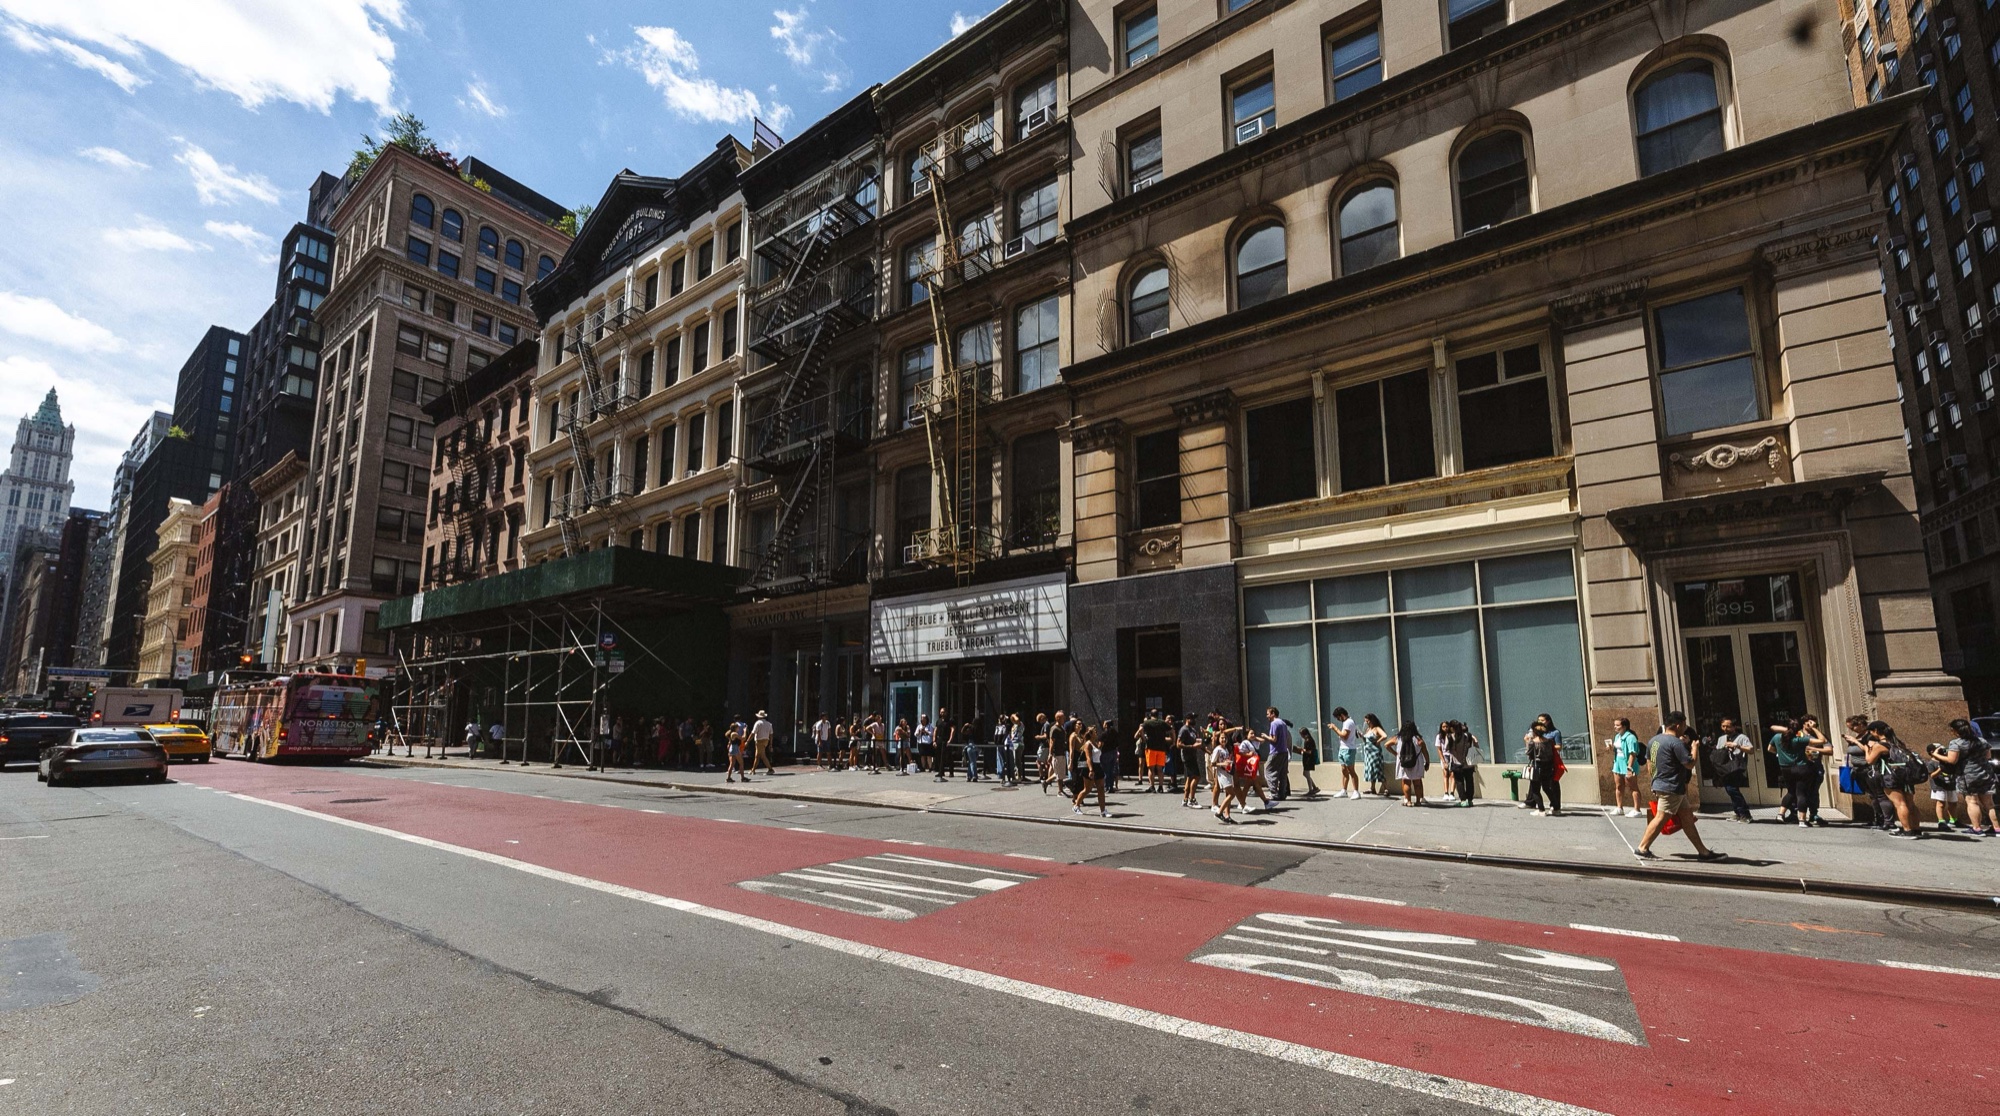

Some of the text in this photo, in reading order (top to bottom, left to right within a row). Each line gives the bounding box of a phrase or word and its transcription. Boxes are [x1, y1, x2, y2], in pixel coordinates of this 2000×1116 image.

[906, 614, 937, 627] JETBLUE
[947, 607, 989, 623] THRILLIST
[993, 602, 1030, 616] PRESENT
[1715, 600, 1755, 616] 395
[944, 624, 976, 637] JETBLUE
[927, 636, 995, 652] TRUEBLUE ARCADE
[298, 719, 364, 729] NORDSTROM
[1188, 911, 1648, 1047] BUS
